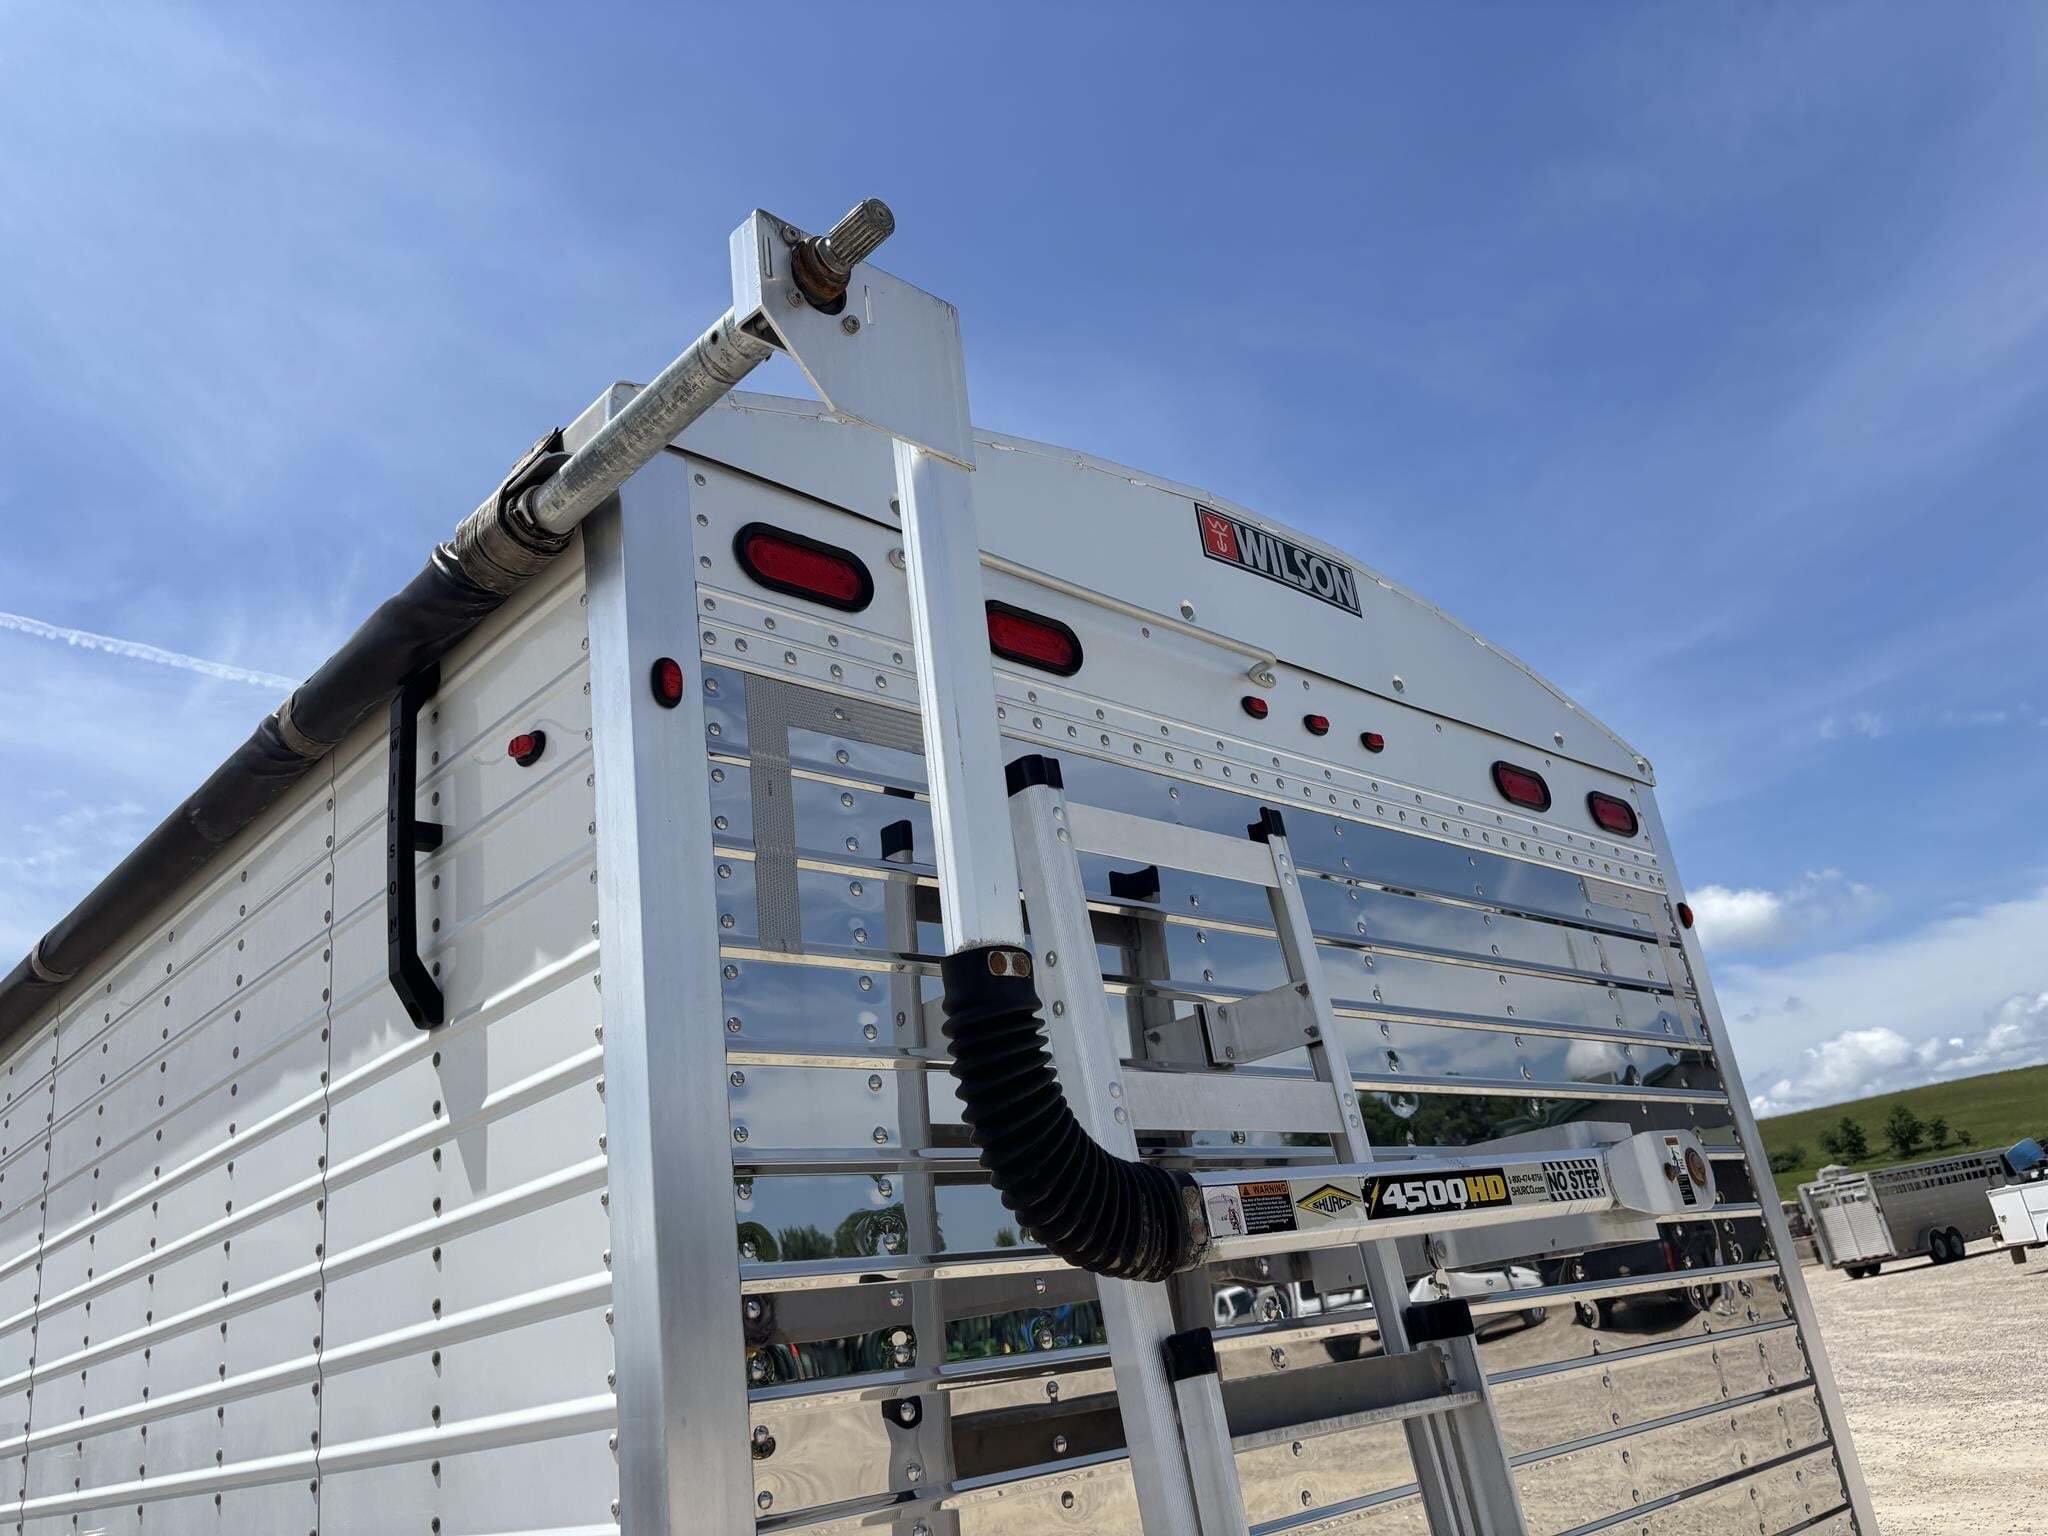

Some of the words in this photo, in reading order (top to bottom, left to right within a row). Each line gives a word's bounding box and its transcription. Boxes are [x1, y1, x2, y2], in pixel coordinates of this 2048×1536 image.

[1233, 523, 1358, 610] WILSON
[390, 736, 398, 931] WILSON
[1253, 1184, 1287, 1194] WARNING
[1547, 1171, 1567, 1191] NO
[1568, 1169, 1599, 1189] STEP
[1312, 1195, 1352, 1212] SHURCO
